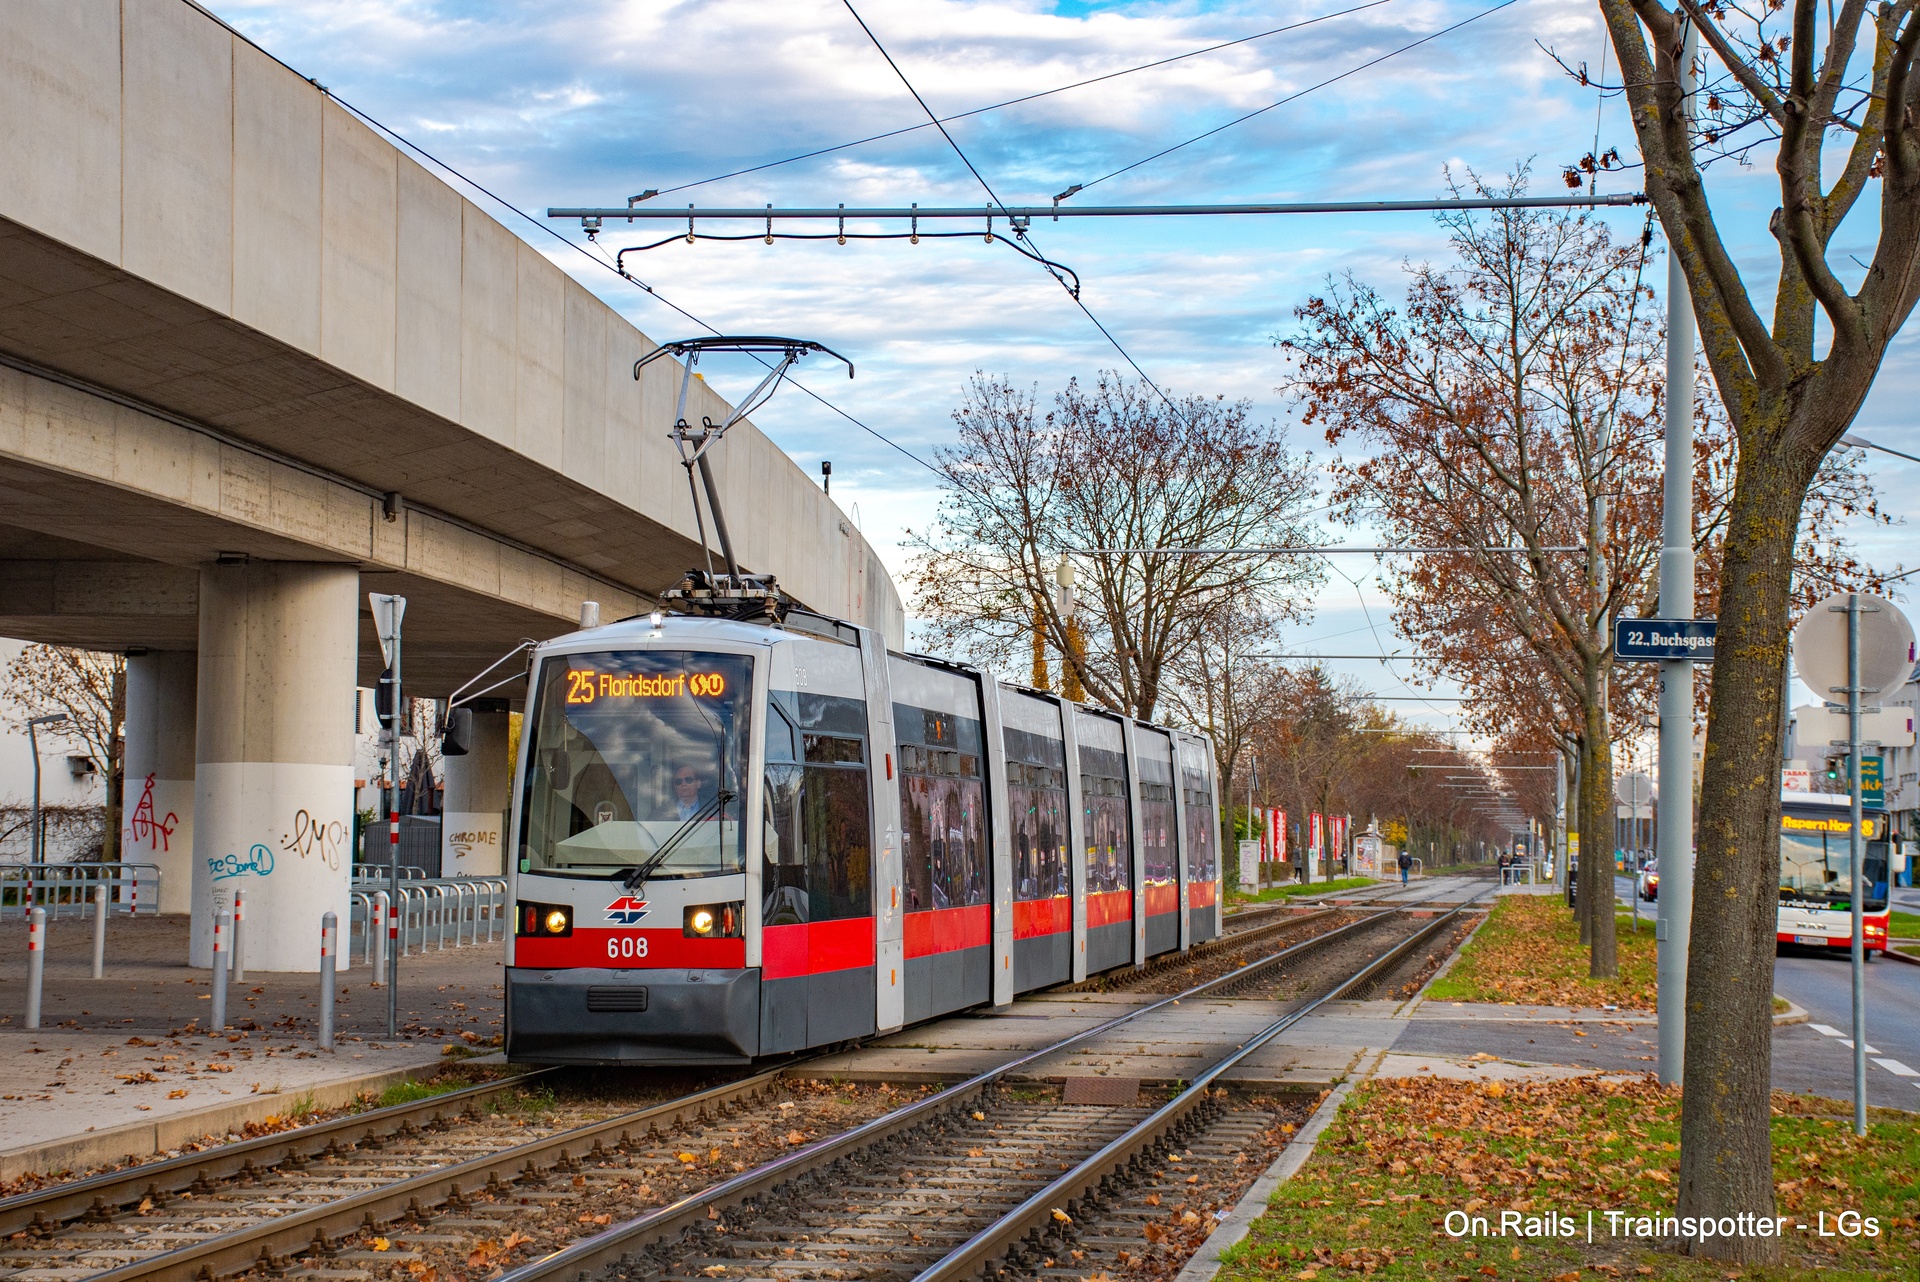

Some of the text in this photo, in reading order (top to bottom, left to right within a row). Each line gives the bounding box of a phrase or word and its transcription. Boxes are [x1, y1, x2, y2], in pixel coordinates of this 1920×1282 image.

[1651, 632, 1716, 650] Buchsgass
[567, 671, 595, 703] 25
[599, 674, 685, 697] Floridsdorf
[449, 831, 497, 845] CHROME
[607, 937, 648, 958] 608
